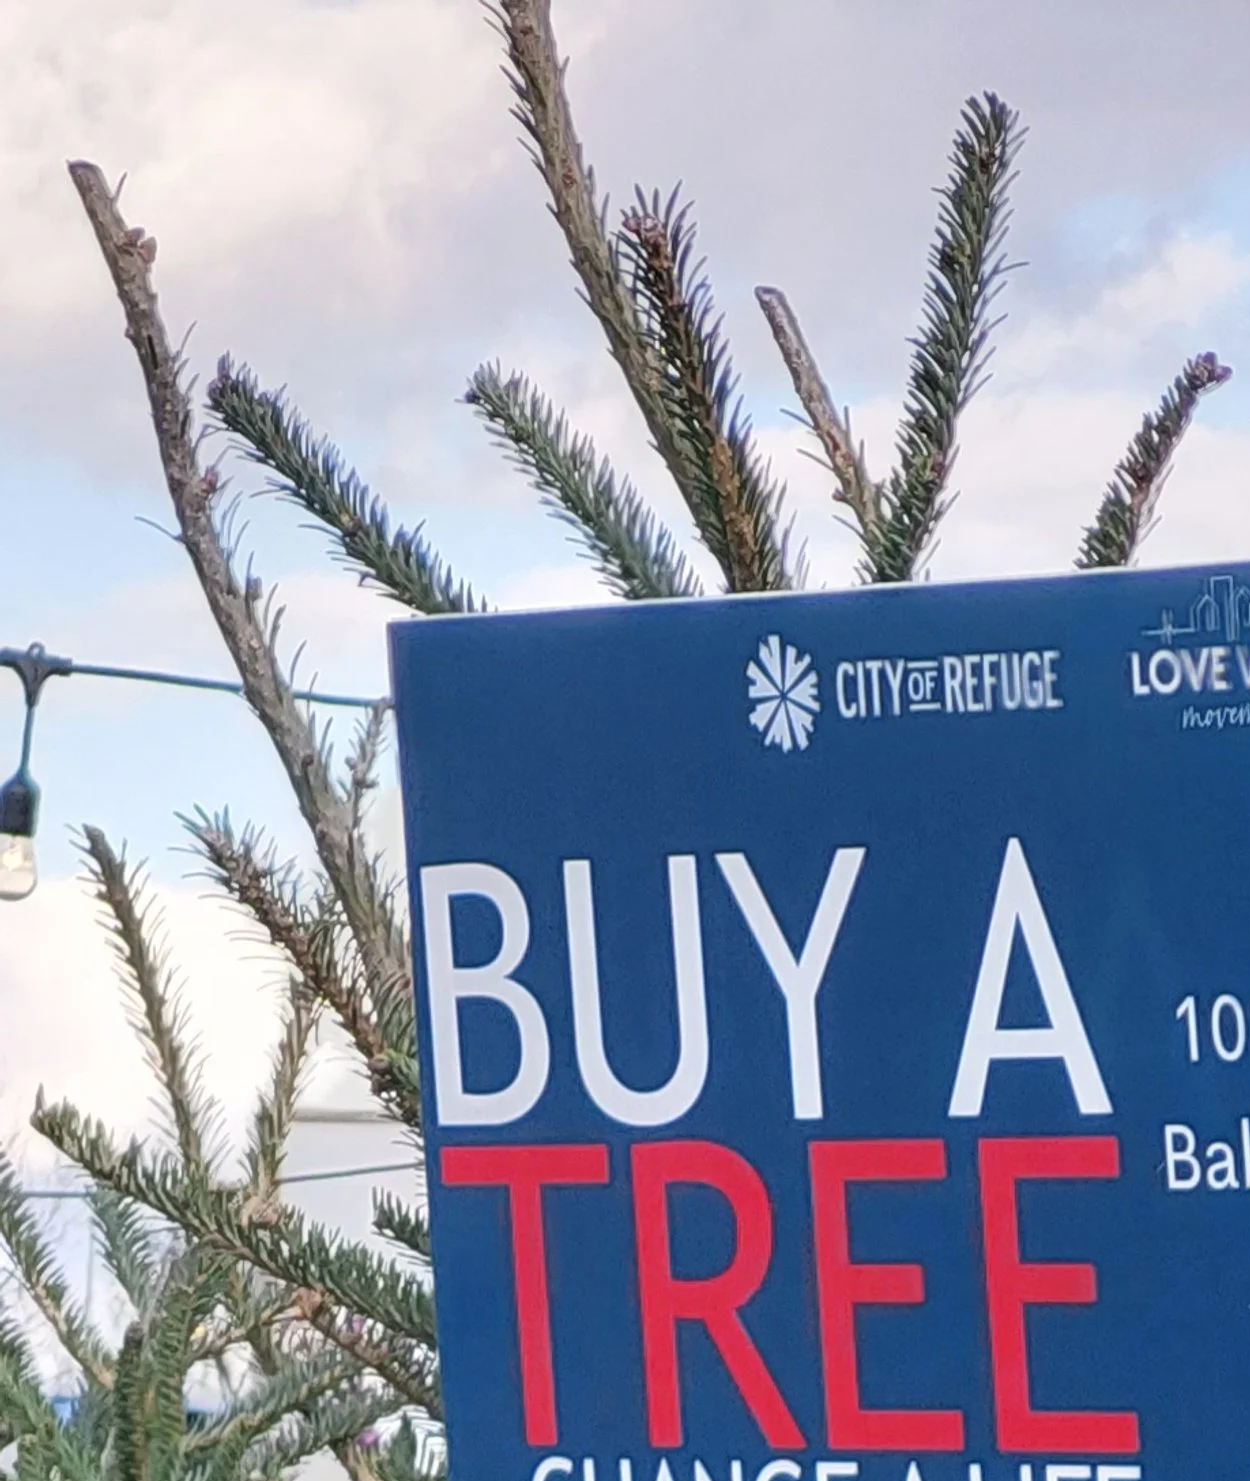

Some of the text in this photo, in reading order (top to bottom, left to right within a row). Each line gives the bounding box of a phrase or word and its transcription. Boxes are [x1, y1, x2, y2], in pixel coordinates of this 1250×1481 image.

[836, 650, 1064, 718] CITY OF REFUGE
[1130, 645, 1232, 695] LOVE
[419, 836, 1114, 1127] BUY A
[440, 1136, 1140, 1454] TREE
